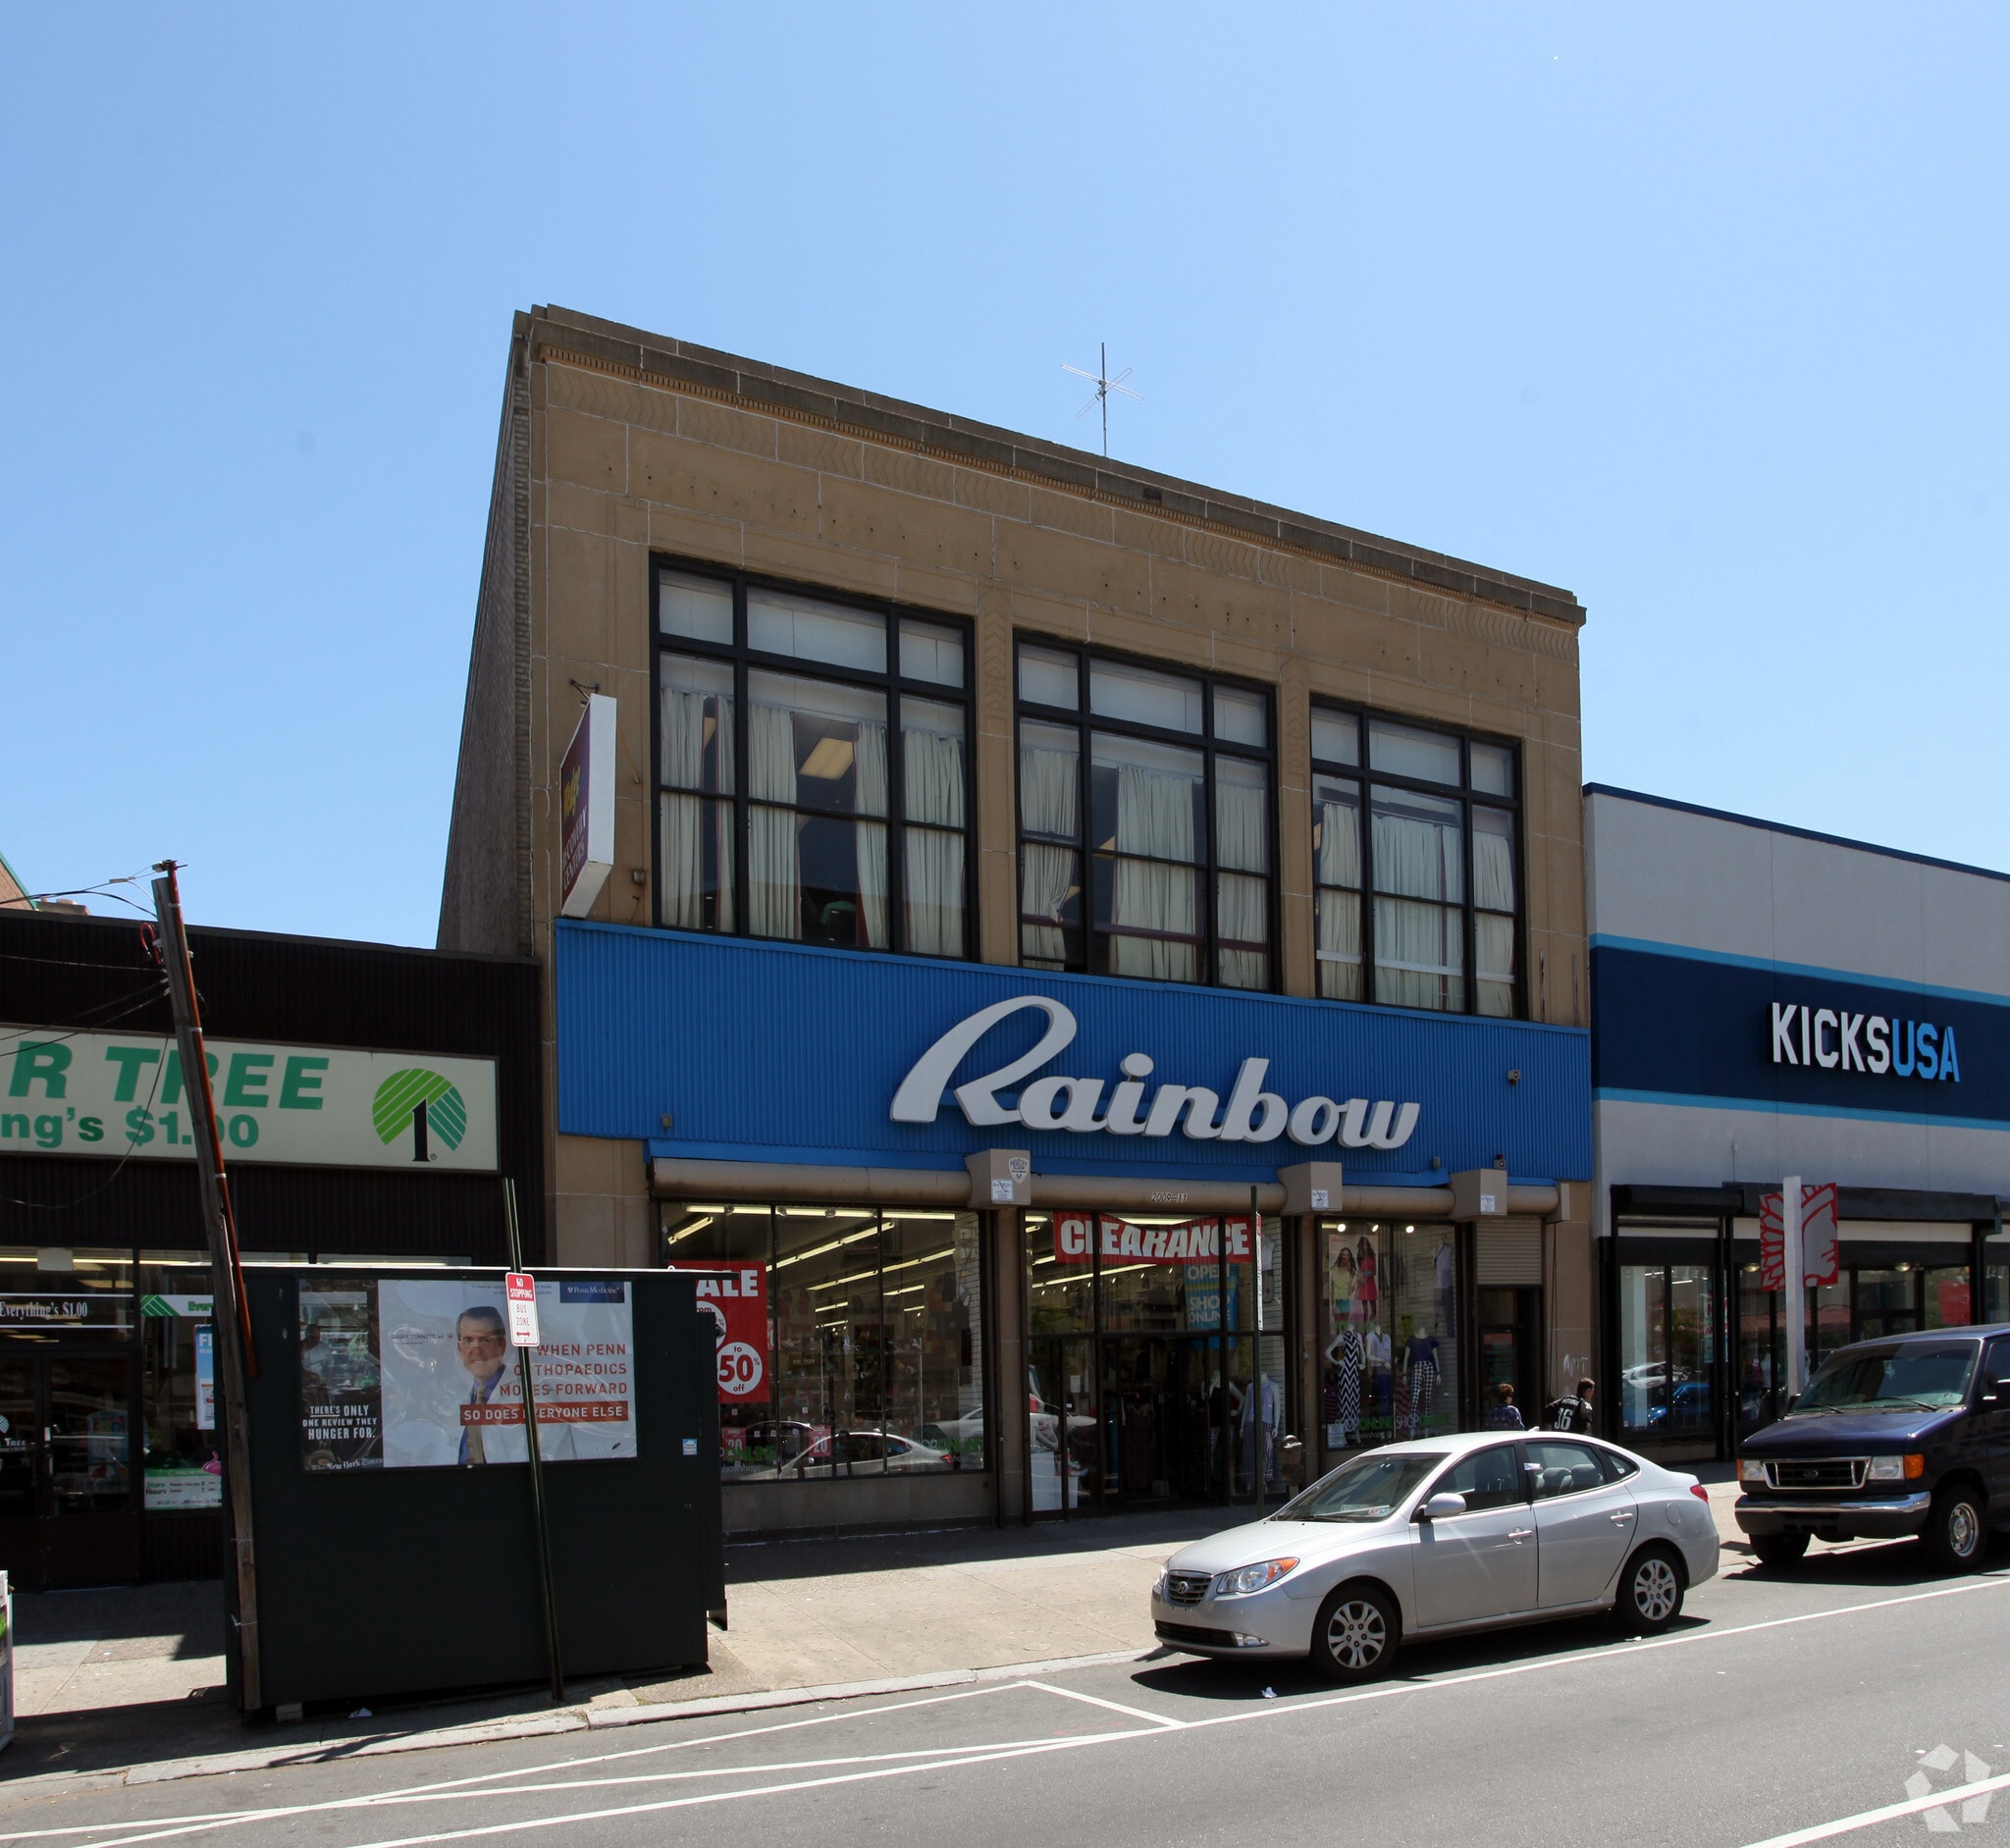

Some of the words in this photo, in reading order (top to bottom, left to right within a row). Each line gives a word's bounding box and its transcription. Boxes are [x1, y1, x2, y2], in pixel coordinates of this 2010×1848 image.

[105, 1046, 330, 1110] TREE
[890, 995, 1420, 1151] Rainbow
[126, 1105, 260, 1148] $1.0
[1188, 1264, 1231, 1280] OPE
[515, 1277, 524, 1287] NO
[696, 1269, 759, 1297] ALE
[509, 1288, 533, 1298] STOPPING
[0, 1301, 59, 1320] Everything's
[63, 1301, 88, 1318] $1.00
[516, 1303, 527, 1313] BUS
[516, 1316, 530, 1326] ZONE
[537, 1345, 581, 1356] WHEN
[587, 1344, 626, 1355] PENN
[513, 1363, 627, 1376] OTHOPAEDICS
[500, 1384, 551, 1397] MOES
[555, 1382, 627, 1395] FORWARD
[310, 1405, 341, 1415] THERE'S
[344, 1404, 369, 1416] ONLY
[463, 1409, 481, 1421] SO
[485, 1408, 518, 1420] DOES
[522, 1406, 588, 1419] ERYONE
[592, 1405, 623, 1416] ELSE
[308, 1428, 349, 1441] HUNGER
[353, 1427, 375, 1439] FOR.
[343, 1459, 361, 1469] York
